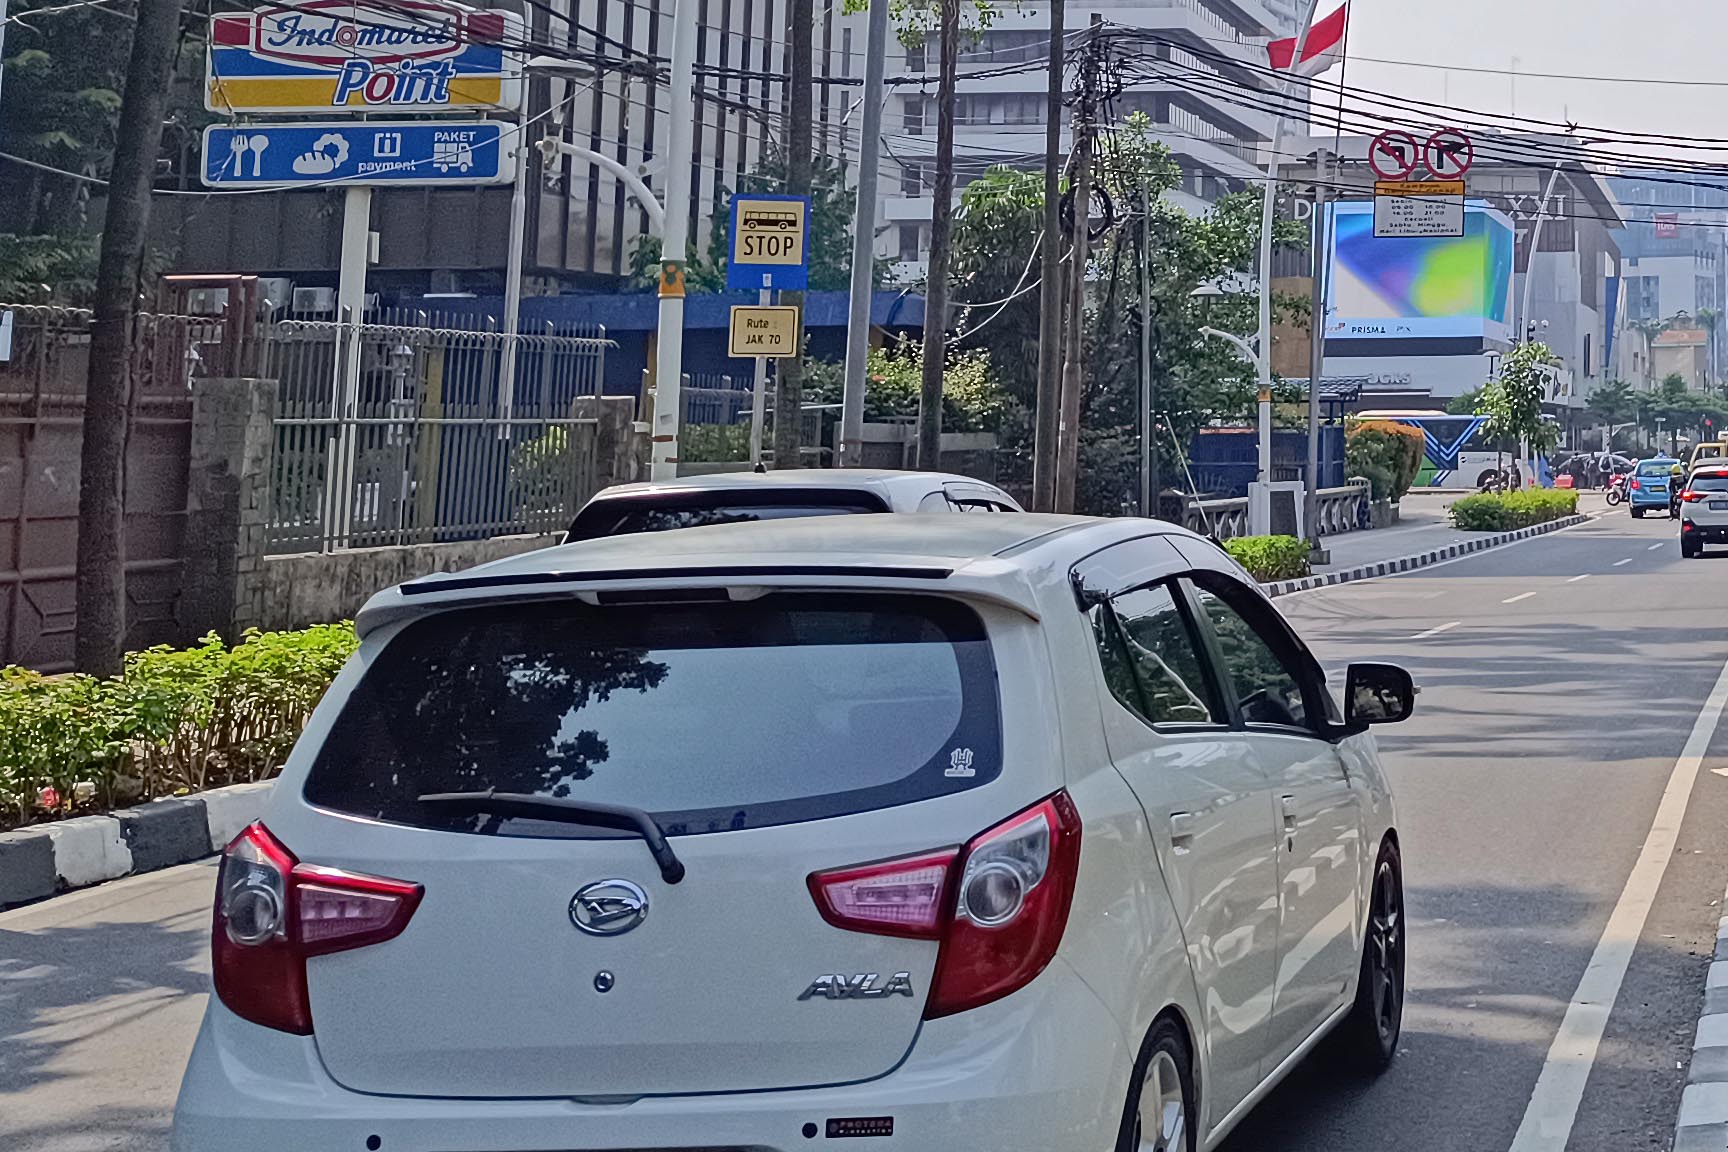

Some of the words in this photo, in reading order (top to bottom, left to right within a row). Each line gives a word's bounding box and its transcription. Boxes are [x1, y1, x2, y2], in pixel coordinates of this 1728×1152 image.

[332, 58, 456, 106] Point
[434, 131, 476, 143] PAKET
[743, 235, 794, 257] STOP
[747, 318, 769, 329] Rute
[745, 334, 763, 345] JAK
[769, 334, 781, 345] 70
